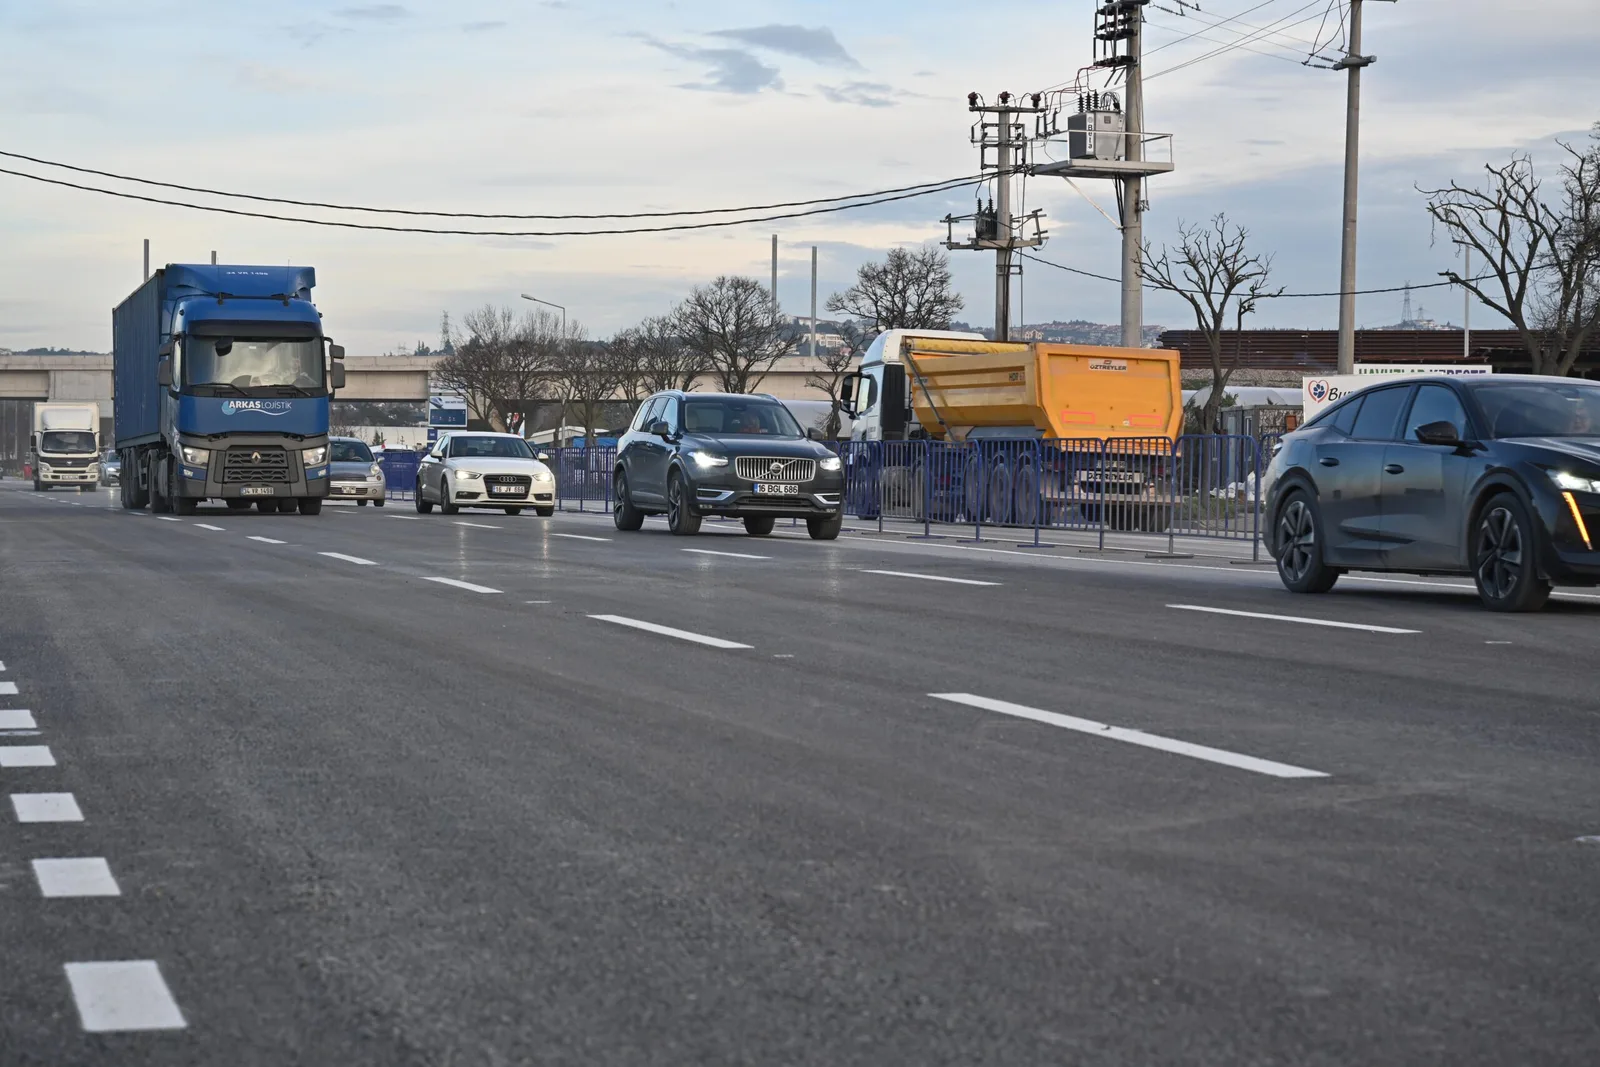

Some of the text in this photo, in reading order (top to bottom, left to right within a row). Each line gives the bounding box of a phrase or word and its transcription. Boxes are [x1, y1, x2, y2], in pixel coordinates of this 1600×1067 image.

[229, 400, 260, 409] ARKAS
[758, 484, 798, 494] 16 BGL 686
